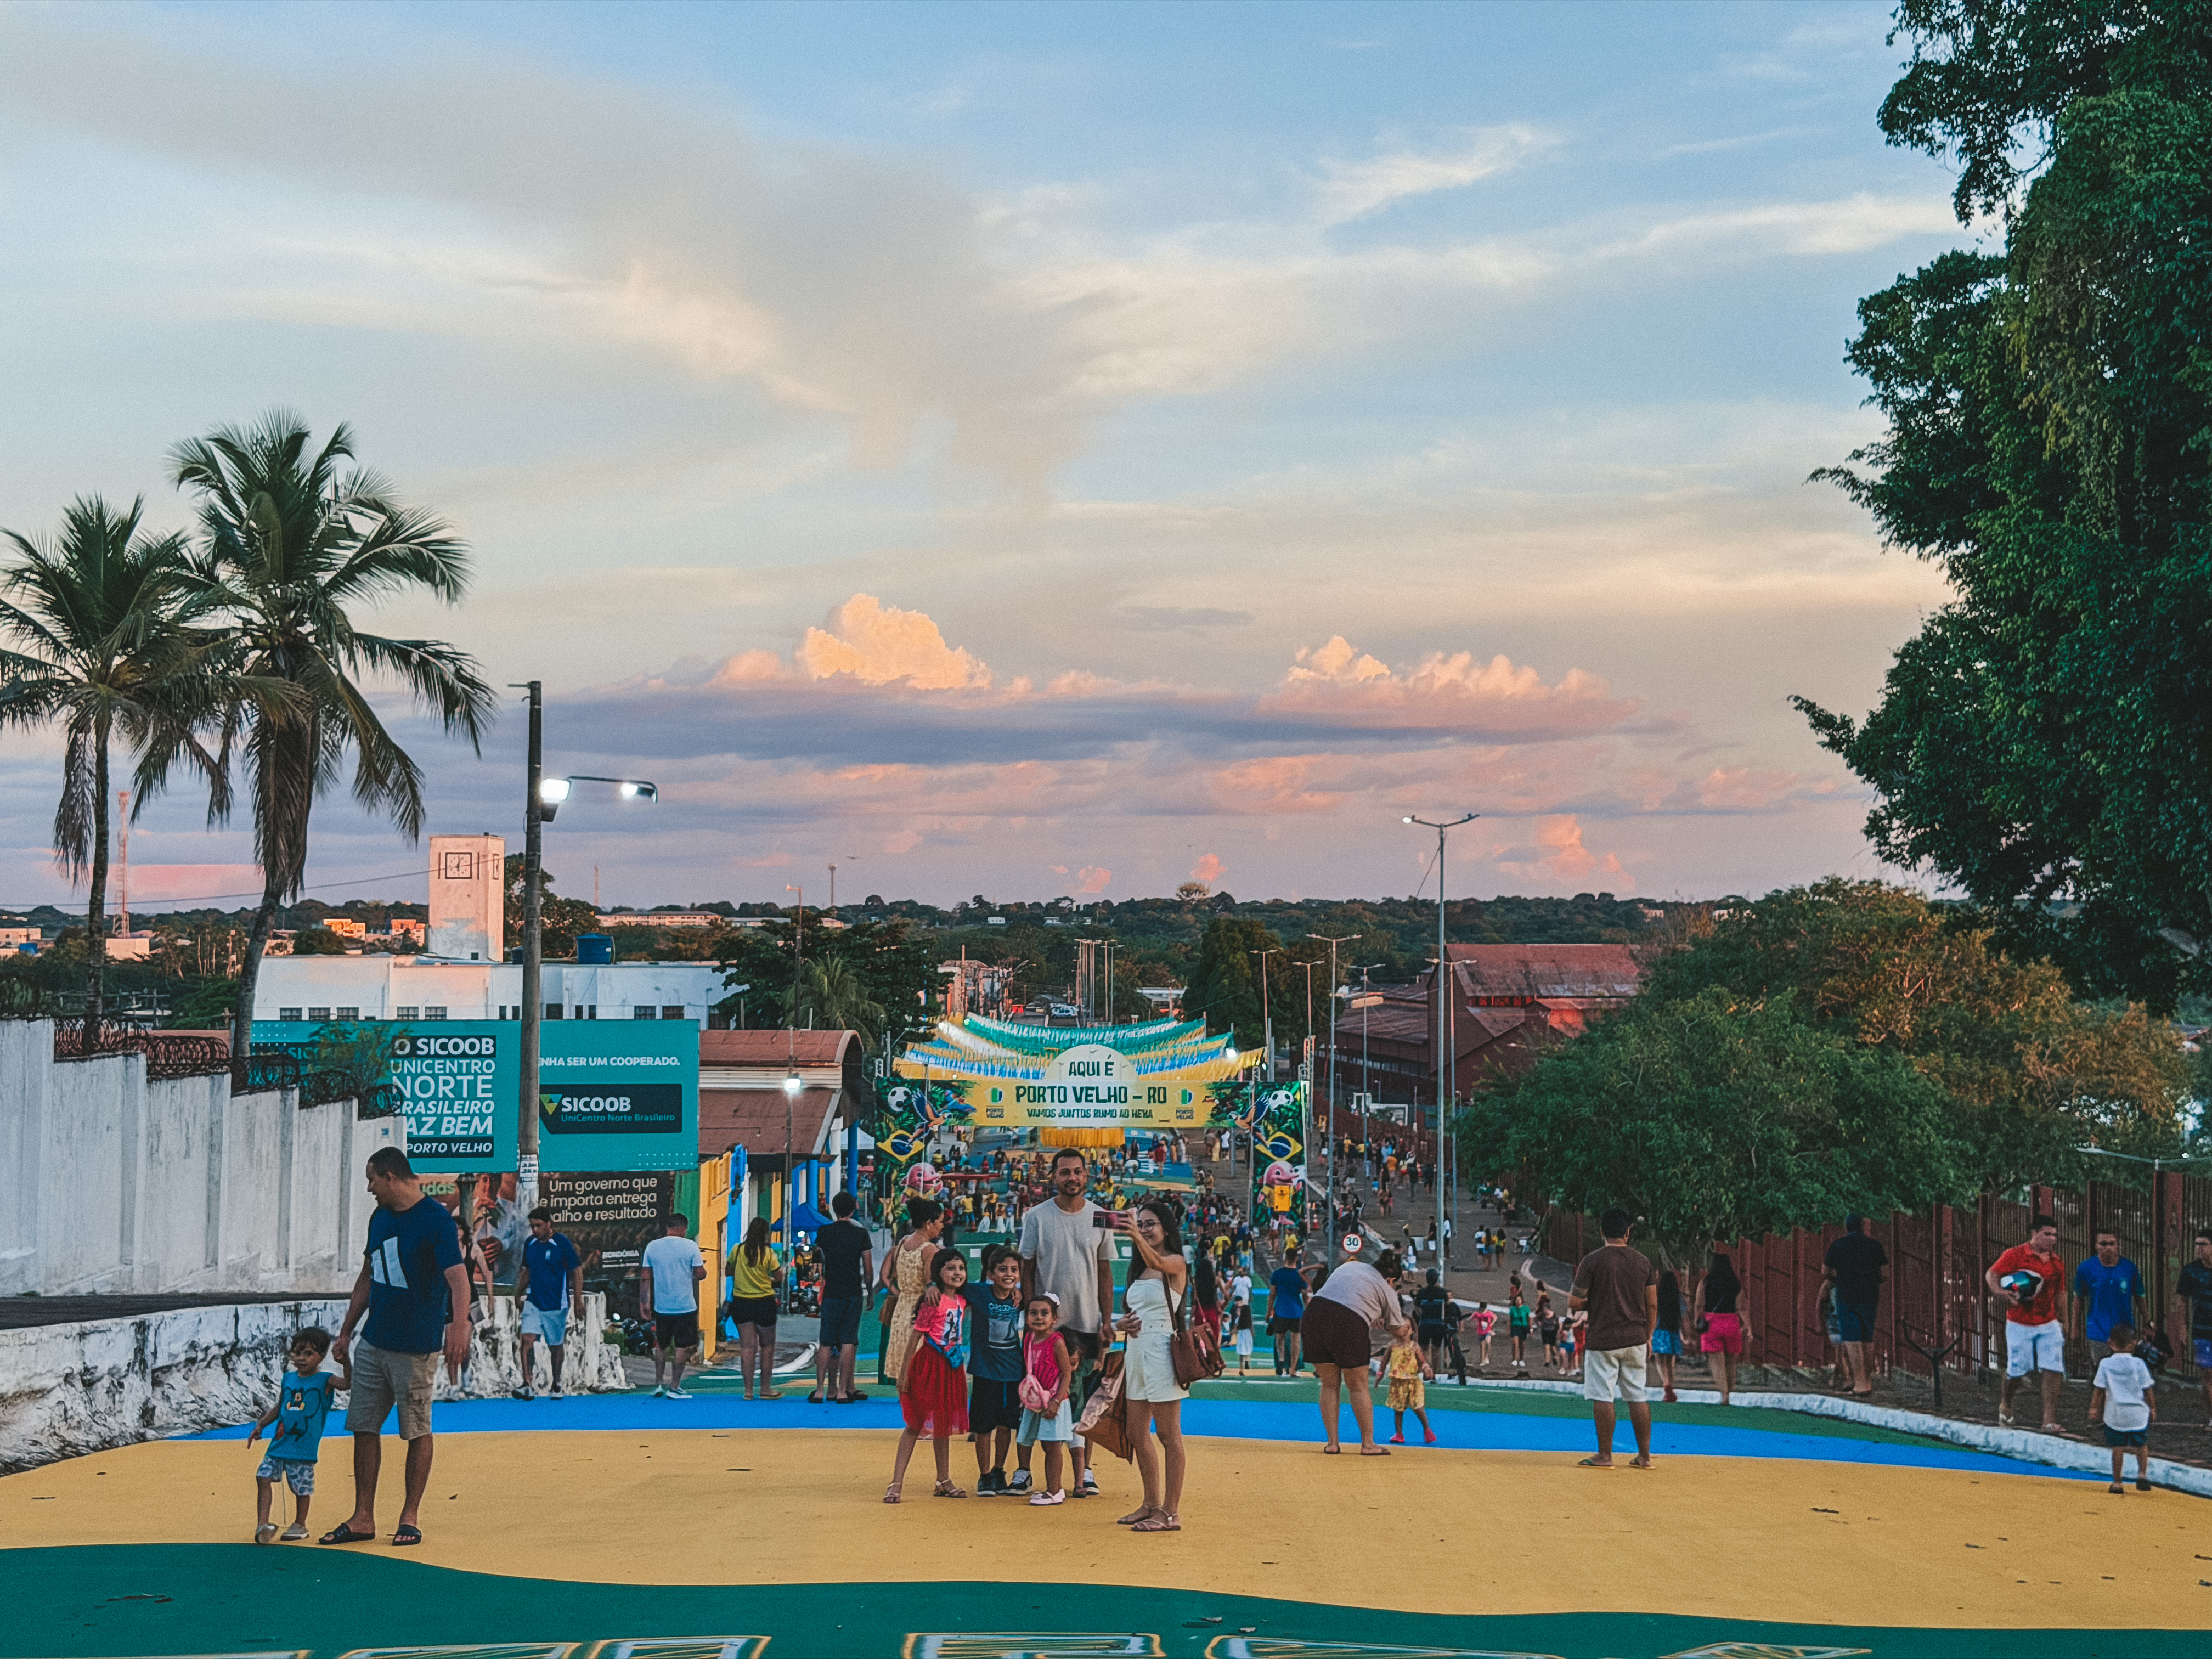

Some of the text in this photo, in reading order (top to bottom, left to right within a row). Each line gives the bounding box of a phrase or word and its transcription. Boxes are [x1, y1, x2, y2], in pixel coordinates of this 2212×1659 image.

[417, 1037, 494, 1055] SICOOB
[390, 1059, 495, 1074] UNICENTRO
[567, 1057, 586, 1066] SER
[589, 1057, 607, 1066] UM
[610, 1056, 680, 1066] COOPERADO.
[1068, 1054, 1114, 1077] AQUI É
[392, 1075, 493, 1098] NORTE
[1015, 1085, 1067, 1103] PORTO
[1072, 1086, 1128, 1103] VELHO
[1147, 1086, 1167, 1104] RO
[561, 1097, 631, 1112] SICOOB
[561, 1113, 675, 1122] UniCentro Norte Brasileiro
[1027, 1108, 1056, 1118] VAMOS
[1058, 1108, 1091, 1118] JUNTOS
[1093, 1108, 1117, 1118] RUMO
[1119, 1109, 1130, 1118] AO
[407, 1116, 493, 1135] AZ BEM
[407, 1142, 492, 1153] PORTO VELHO
[549, 1178, 658, 1194] Um governo que
[550, 1194, 603, 1210] importa
[606, 1192, 657, 1206] entrega
[550, 1206, 657, 1223] alho e resultado
[1346, 1237, 1359, 1246] 30
